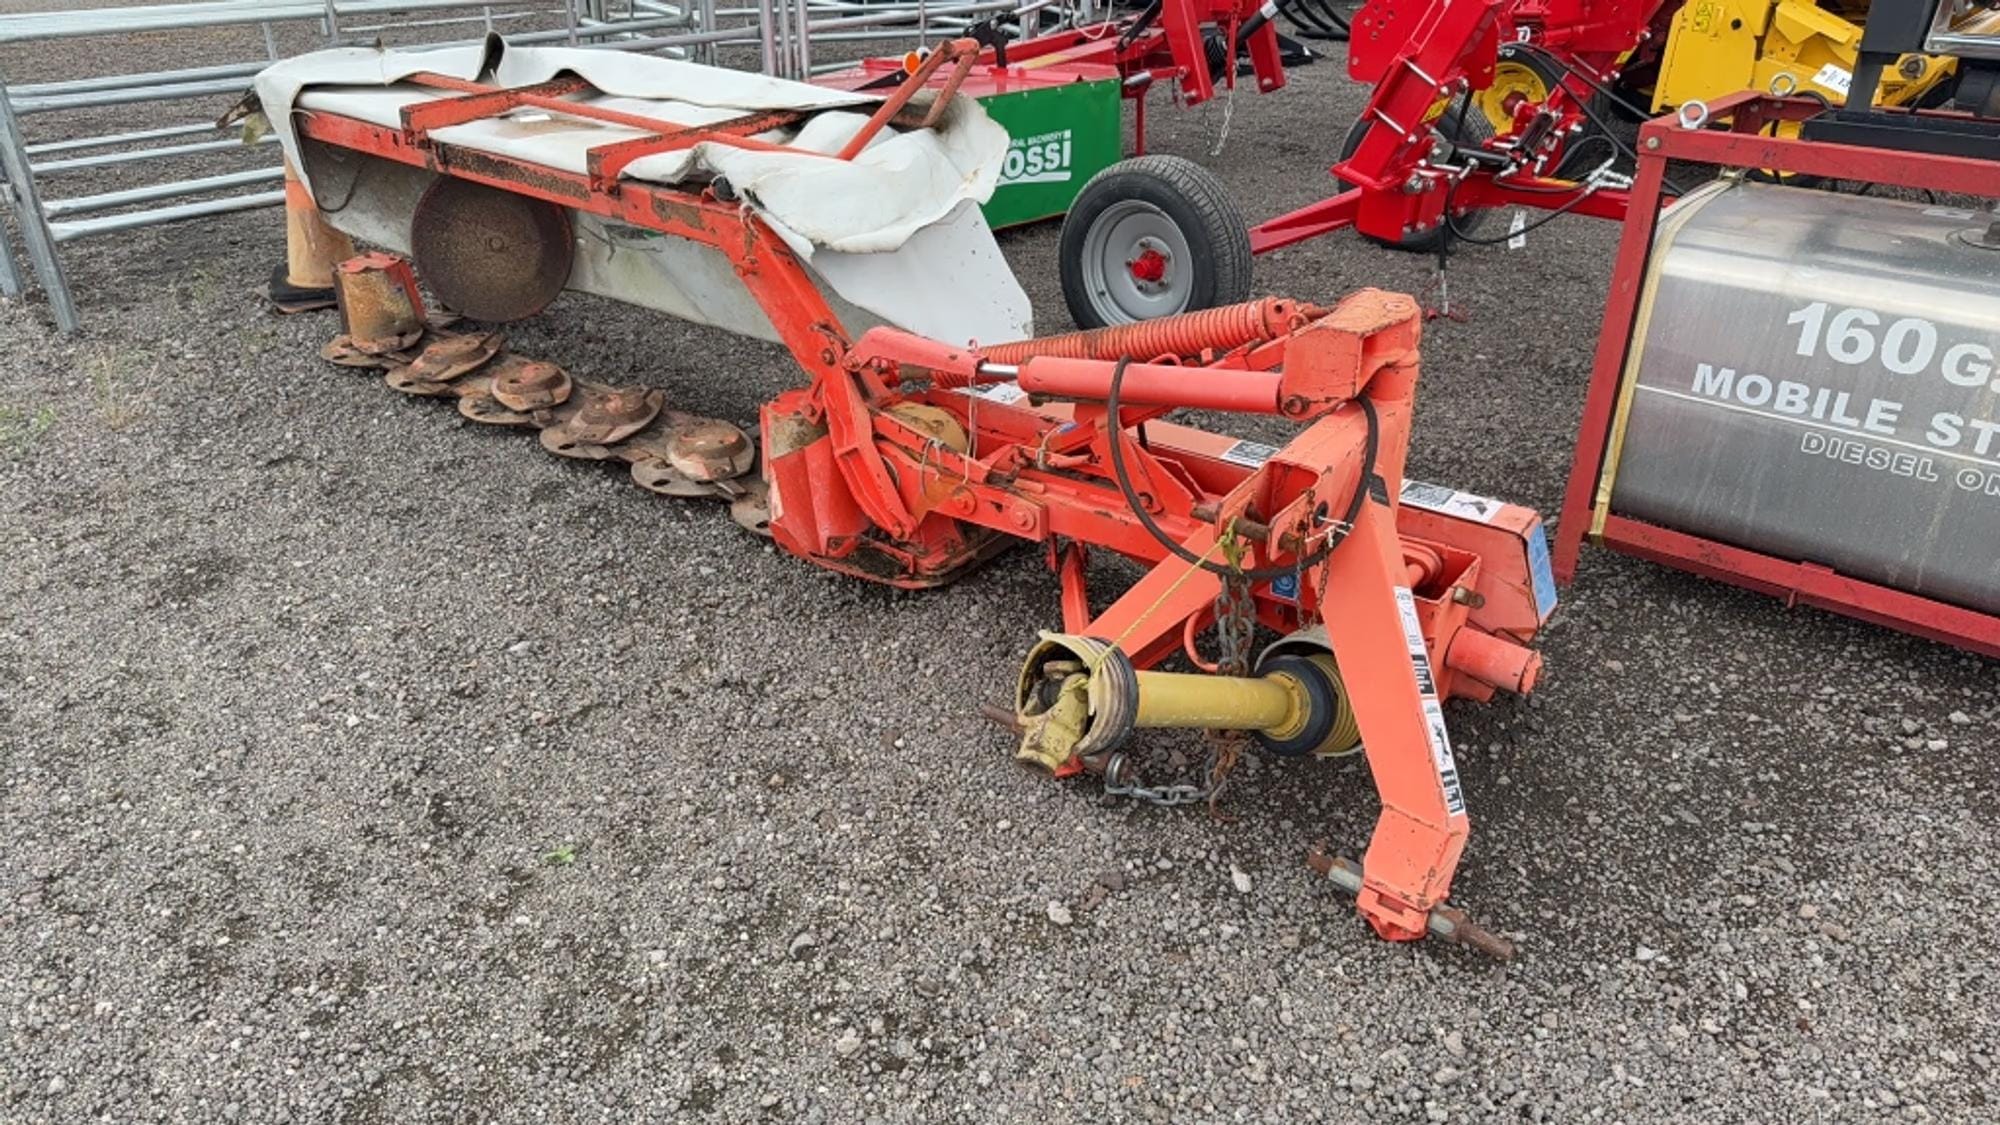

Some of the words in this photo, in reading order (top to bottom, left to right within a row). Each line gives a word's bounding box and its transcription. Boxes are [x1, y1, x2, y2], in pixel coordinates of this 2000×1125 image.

[1003, 129, 1071, 179] OSSI
[1690, 362, 1904, 436] MOBILE
[1925, 411, 2000, 459] ST
[1800, 431, 1939, 482] DIESEL
